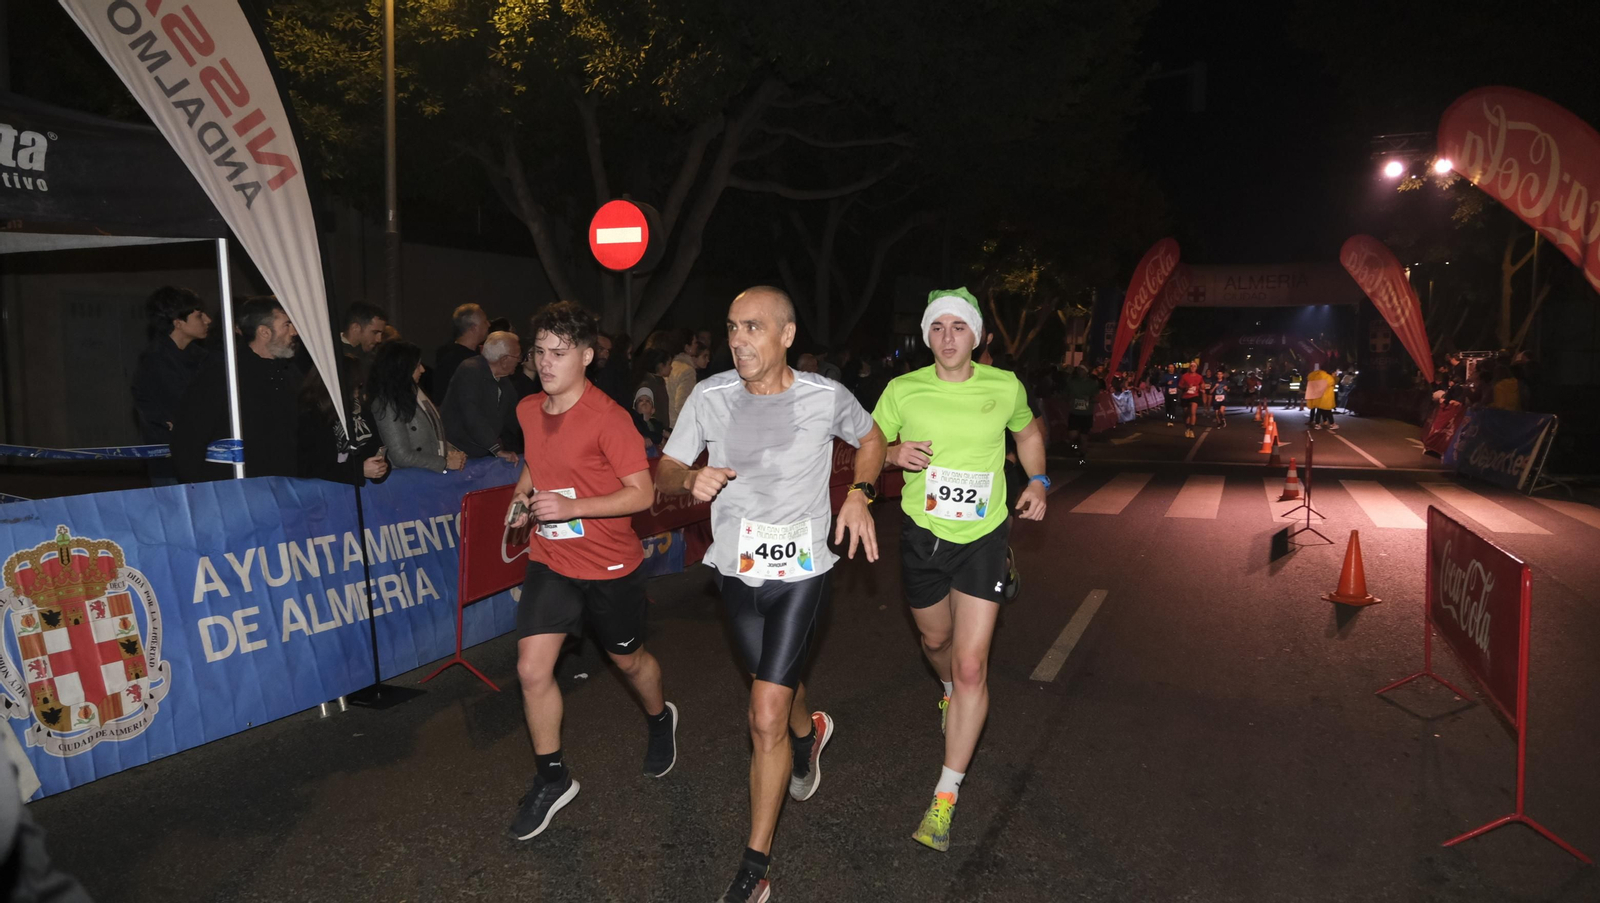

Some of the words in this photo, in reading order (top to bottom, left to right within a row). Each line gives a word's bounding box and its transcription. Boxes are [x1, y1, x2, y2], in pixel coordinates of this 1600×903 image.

[938, 485, 978, 503] 932
[755, 541, 797, 561] 460
[198, 606, 267, 663] DE
[282, 562, 440, 643] ALMERÍA
[149, 627, 158, 668] LIBERTAD
[58, 735, 94, 752] CIUDAD
[95, 729, 107, 739] DE
